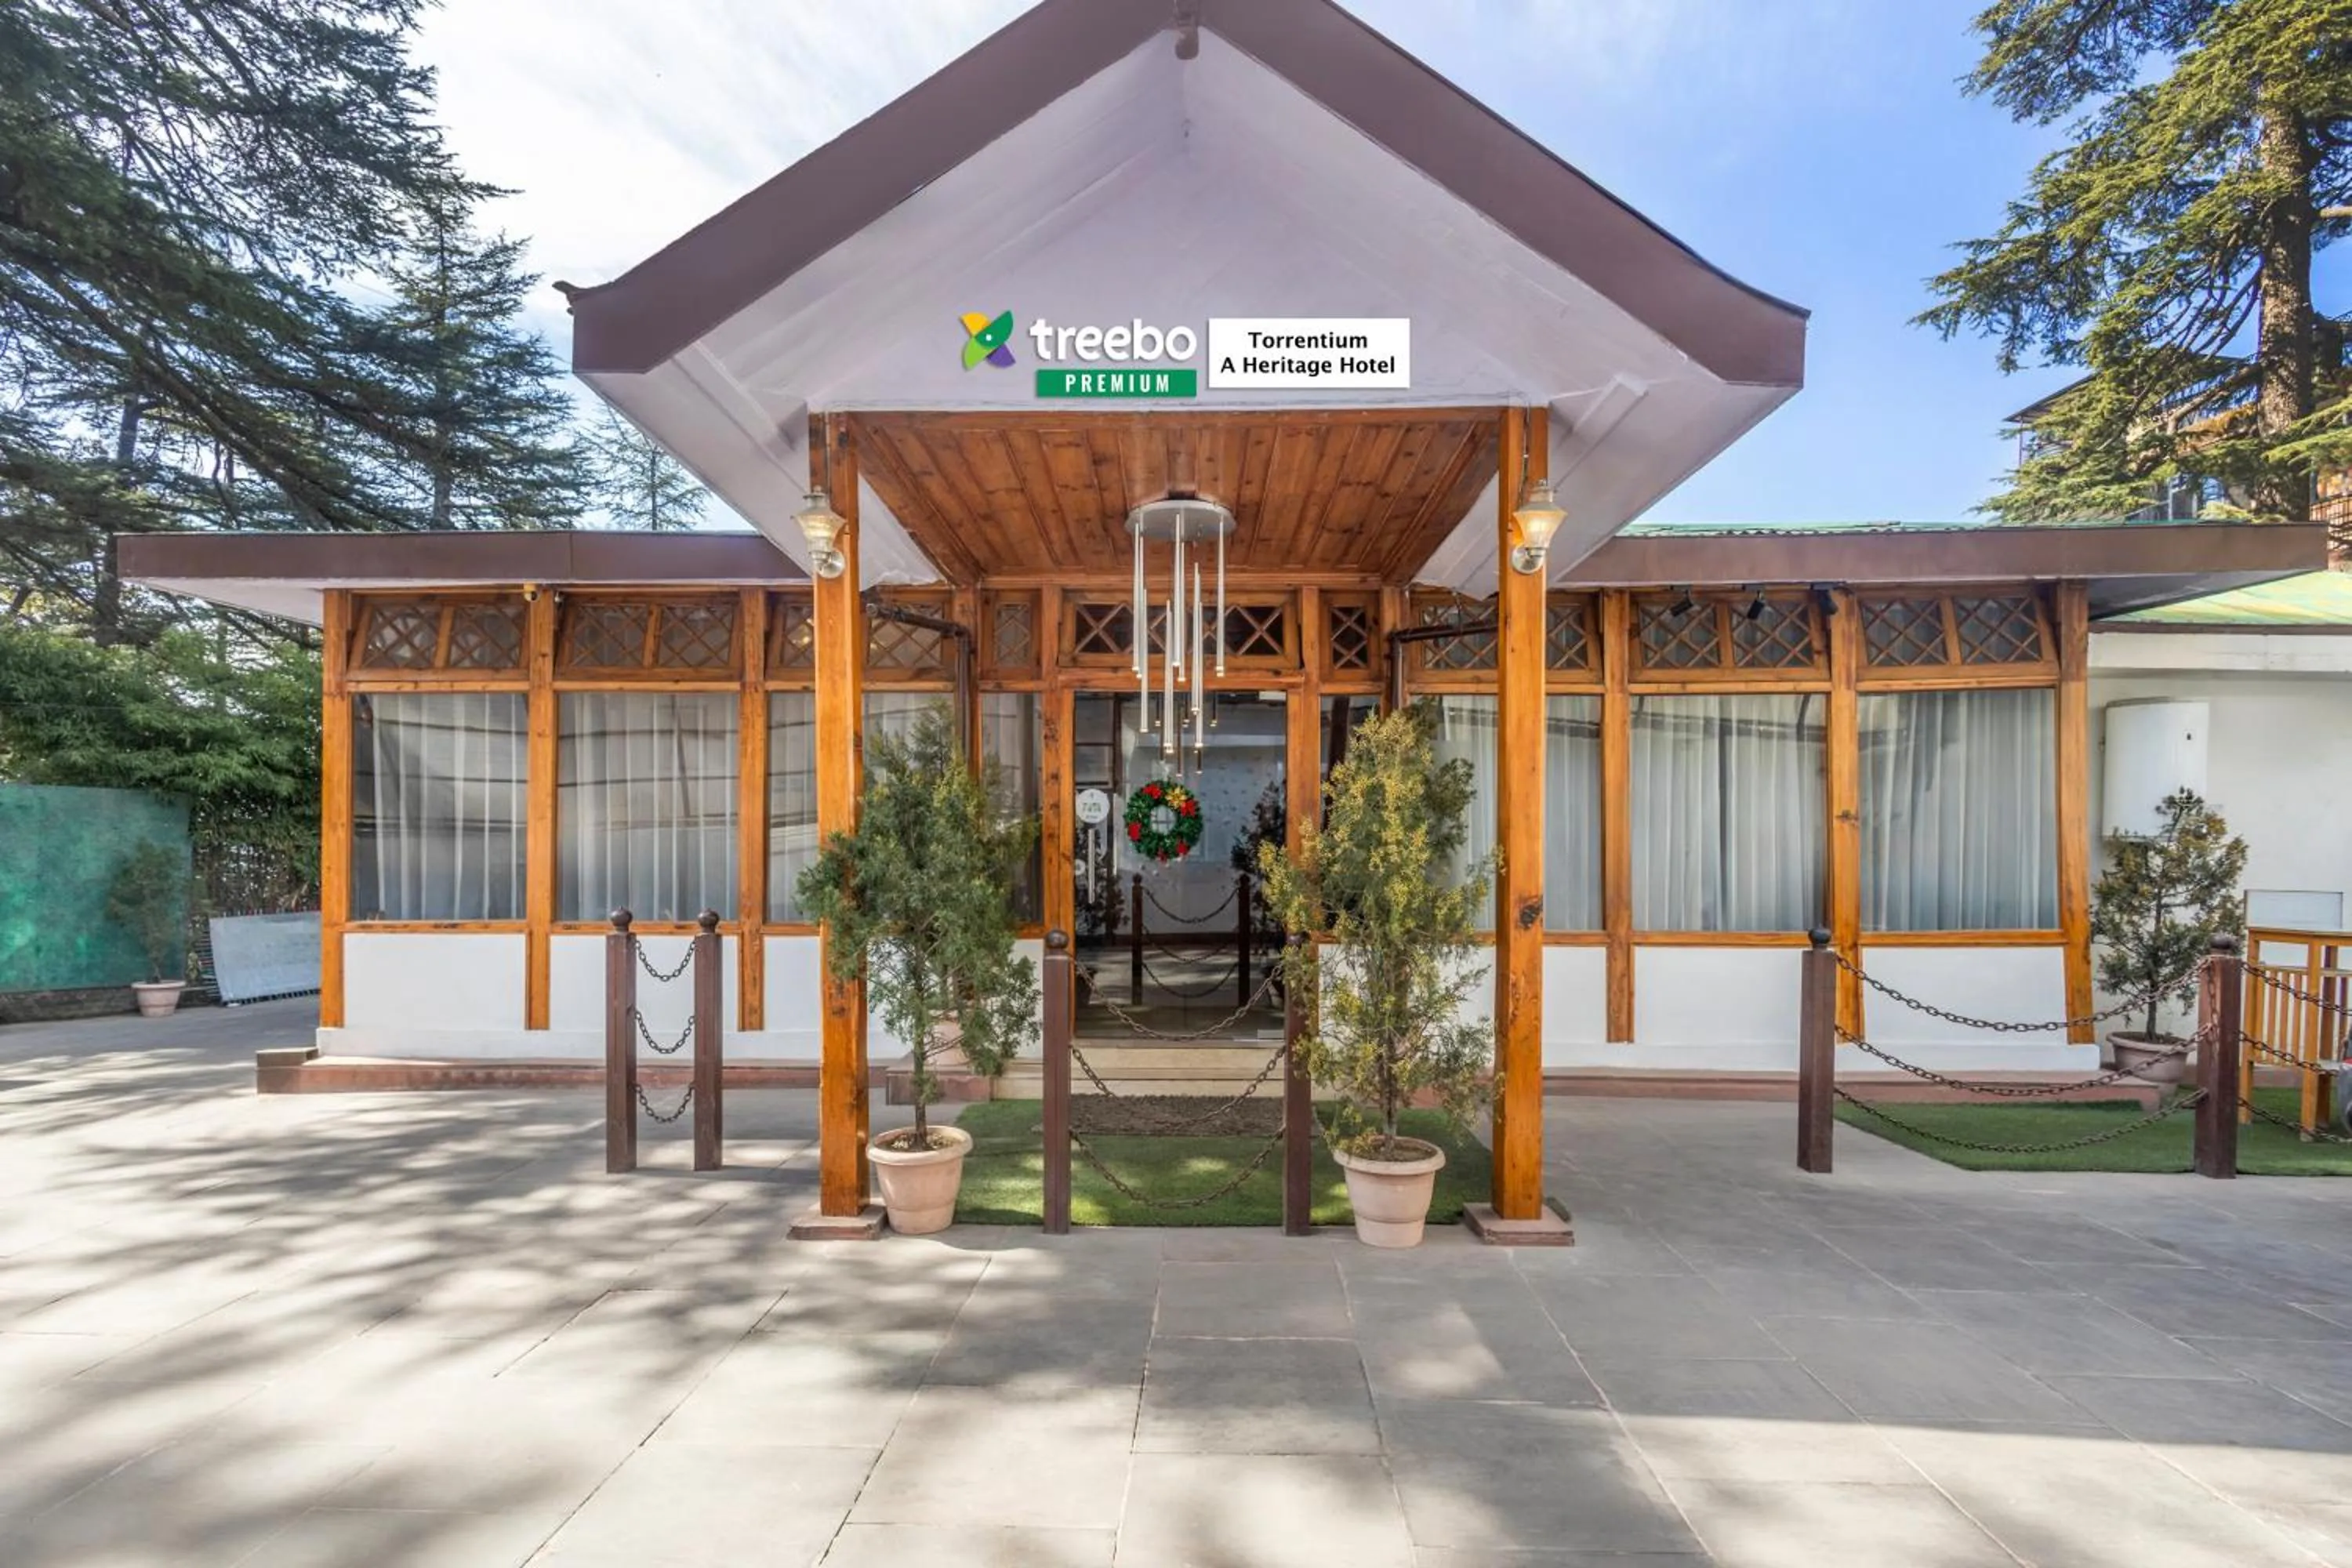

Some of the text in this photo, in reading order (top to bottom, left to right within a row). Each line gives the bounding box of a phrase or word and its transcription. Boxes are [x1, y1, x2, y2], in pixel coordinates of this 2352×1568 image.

[1029, 318, 1198, 361] treebo
[1247, 332, 1368, 350] Torrentium
[1220, 356, 1396, 377] A Heritage Hotel
[1065, 374, 1170, 393] PREMIUM
